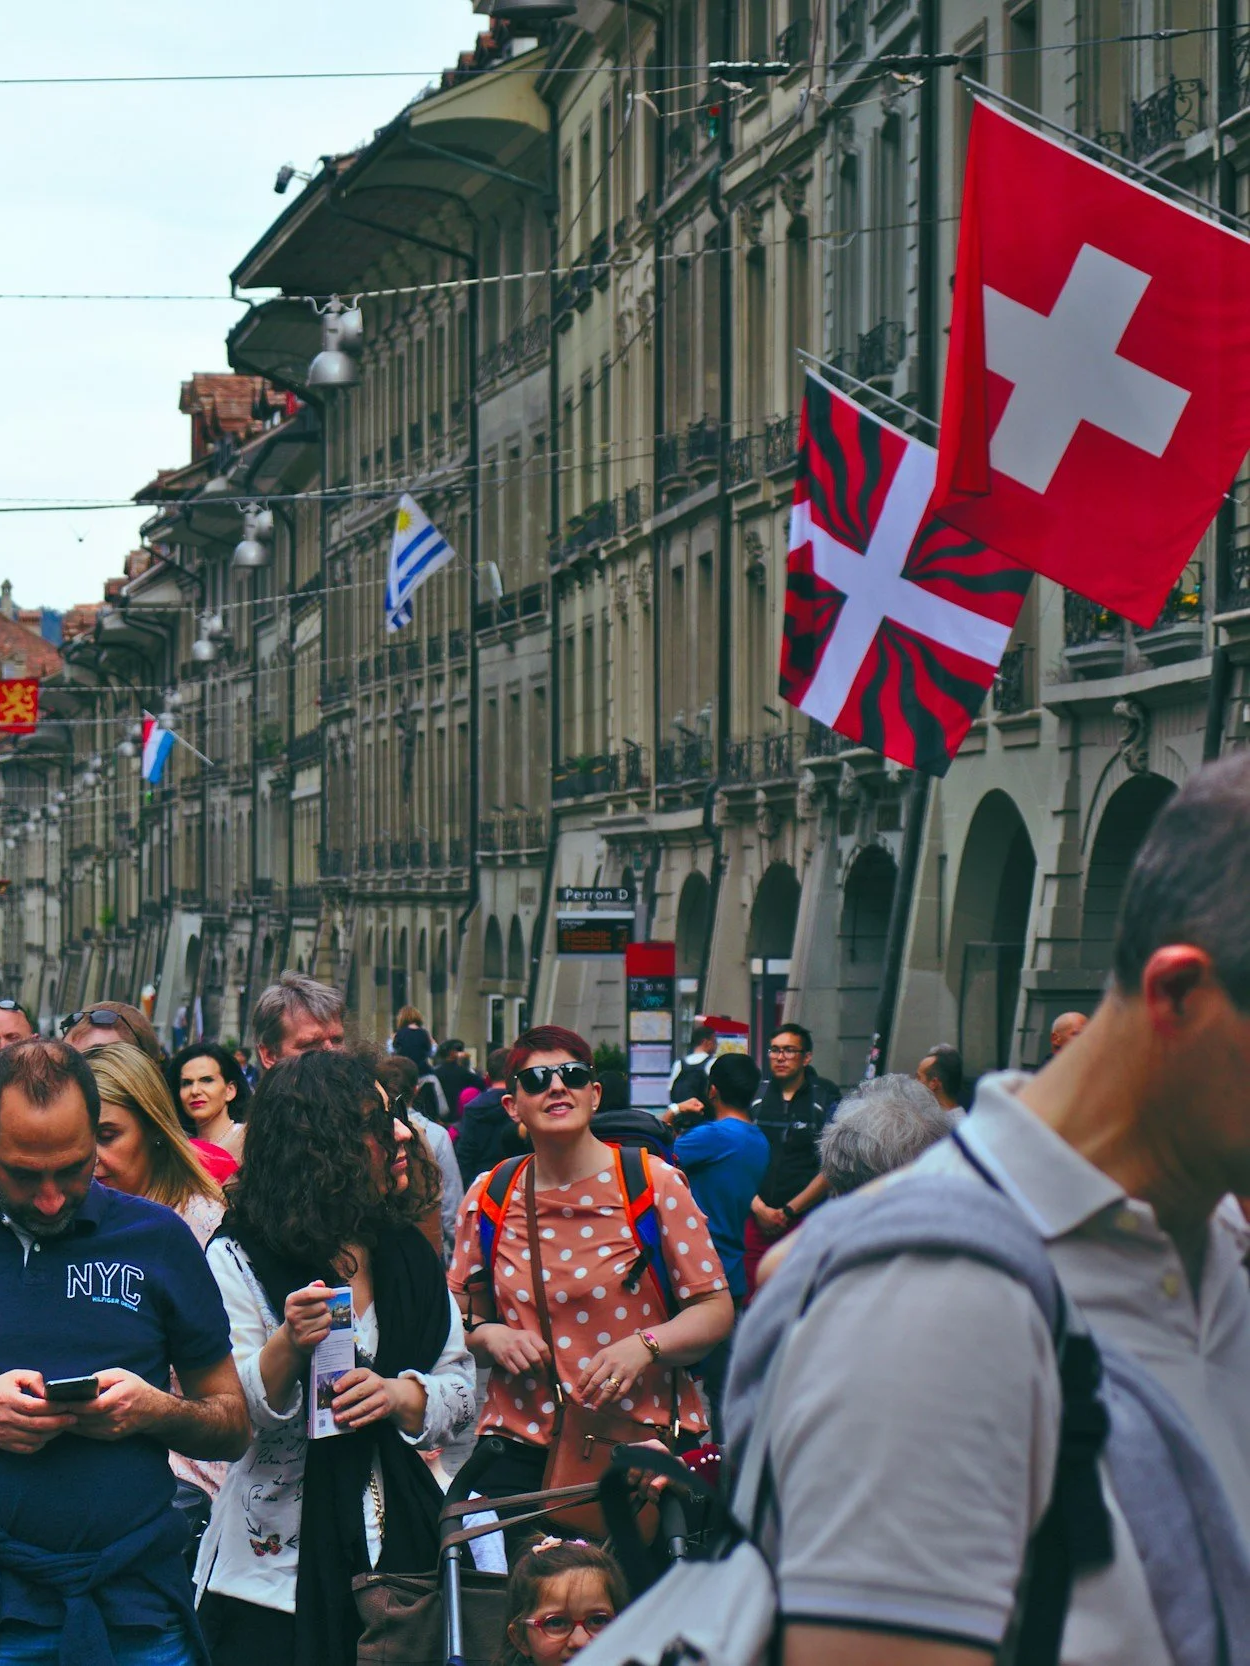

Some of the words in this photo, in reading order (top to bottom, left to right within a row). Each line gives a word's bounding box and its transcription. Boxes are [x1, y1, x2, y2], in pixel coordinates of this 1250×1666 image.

[565, 889, 613, 900] Perron
[619, 888, 629, 900] D
[67, 1261, 144, 1306] NYC
[92, 1296, 120, 1304] HILFIGER
